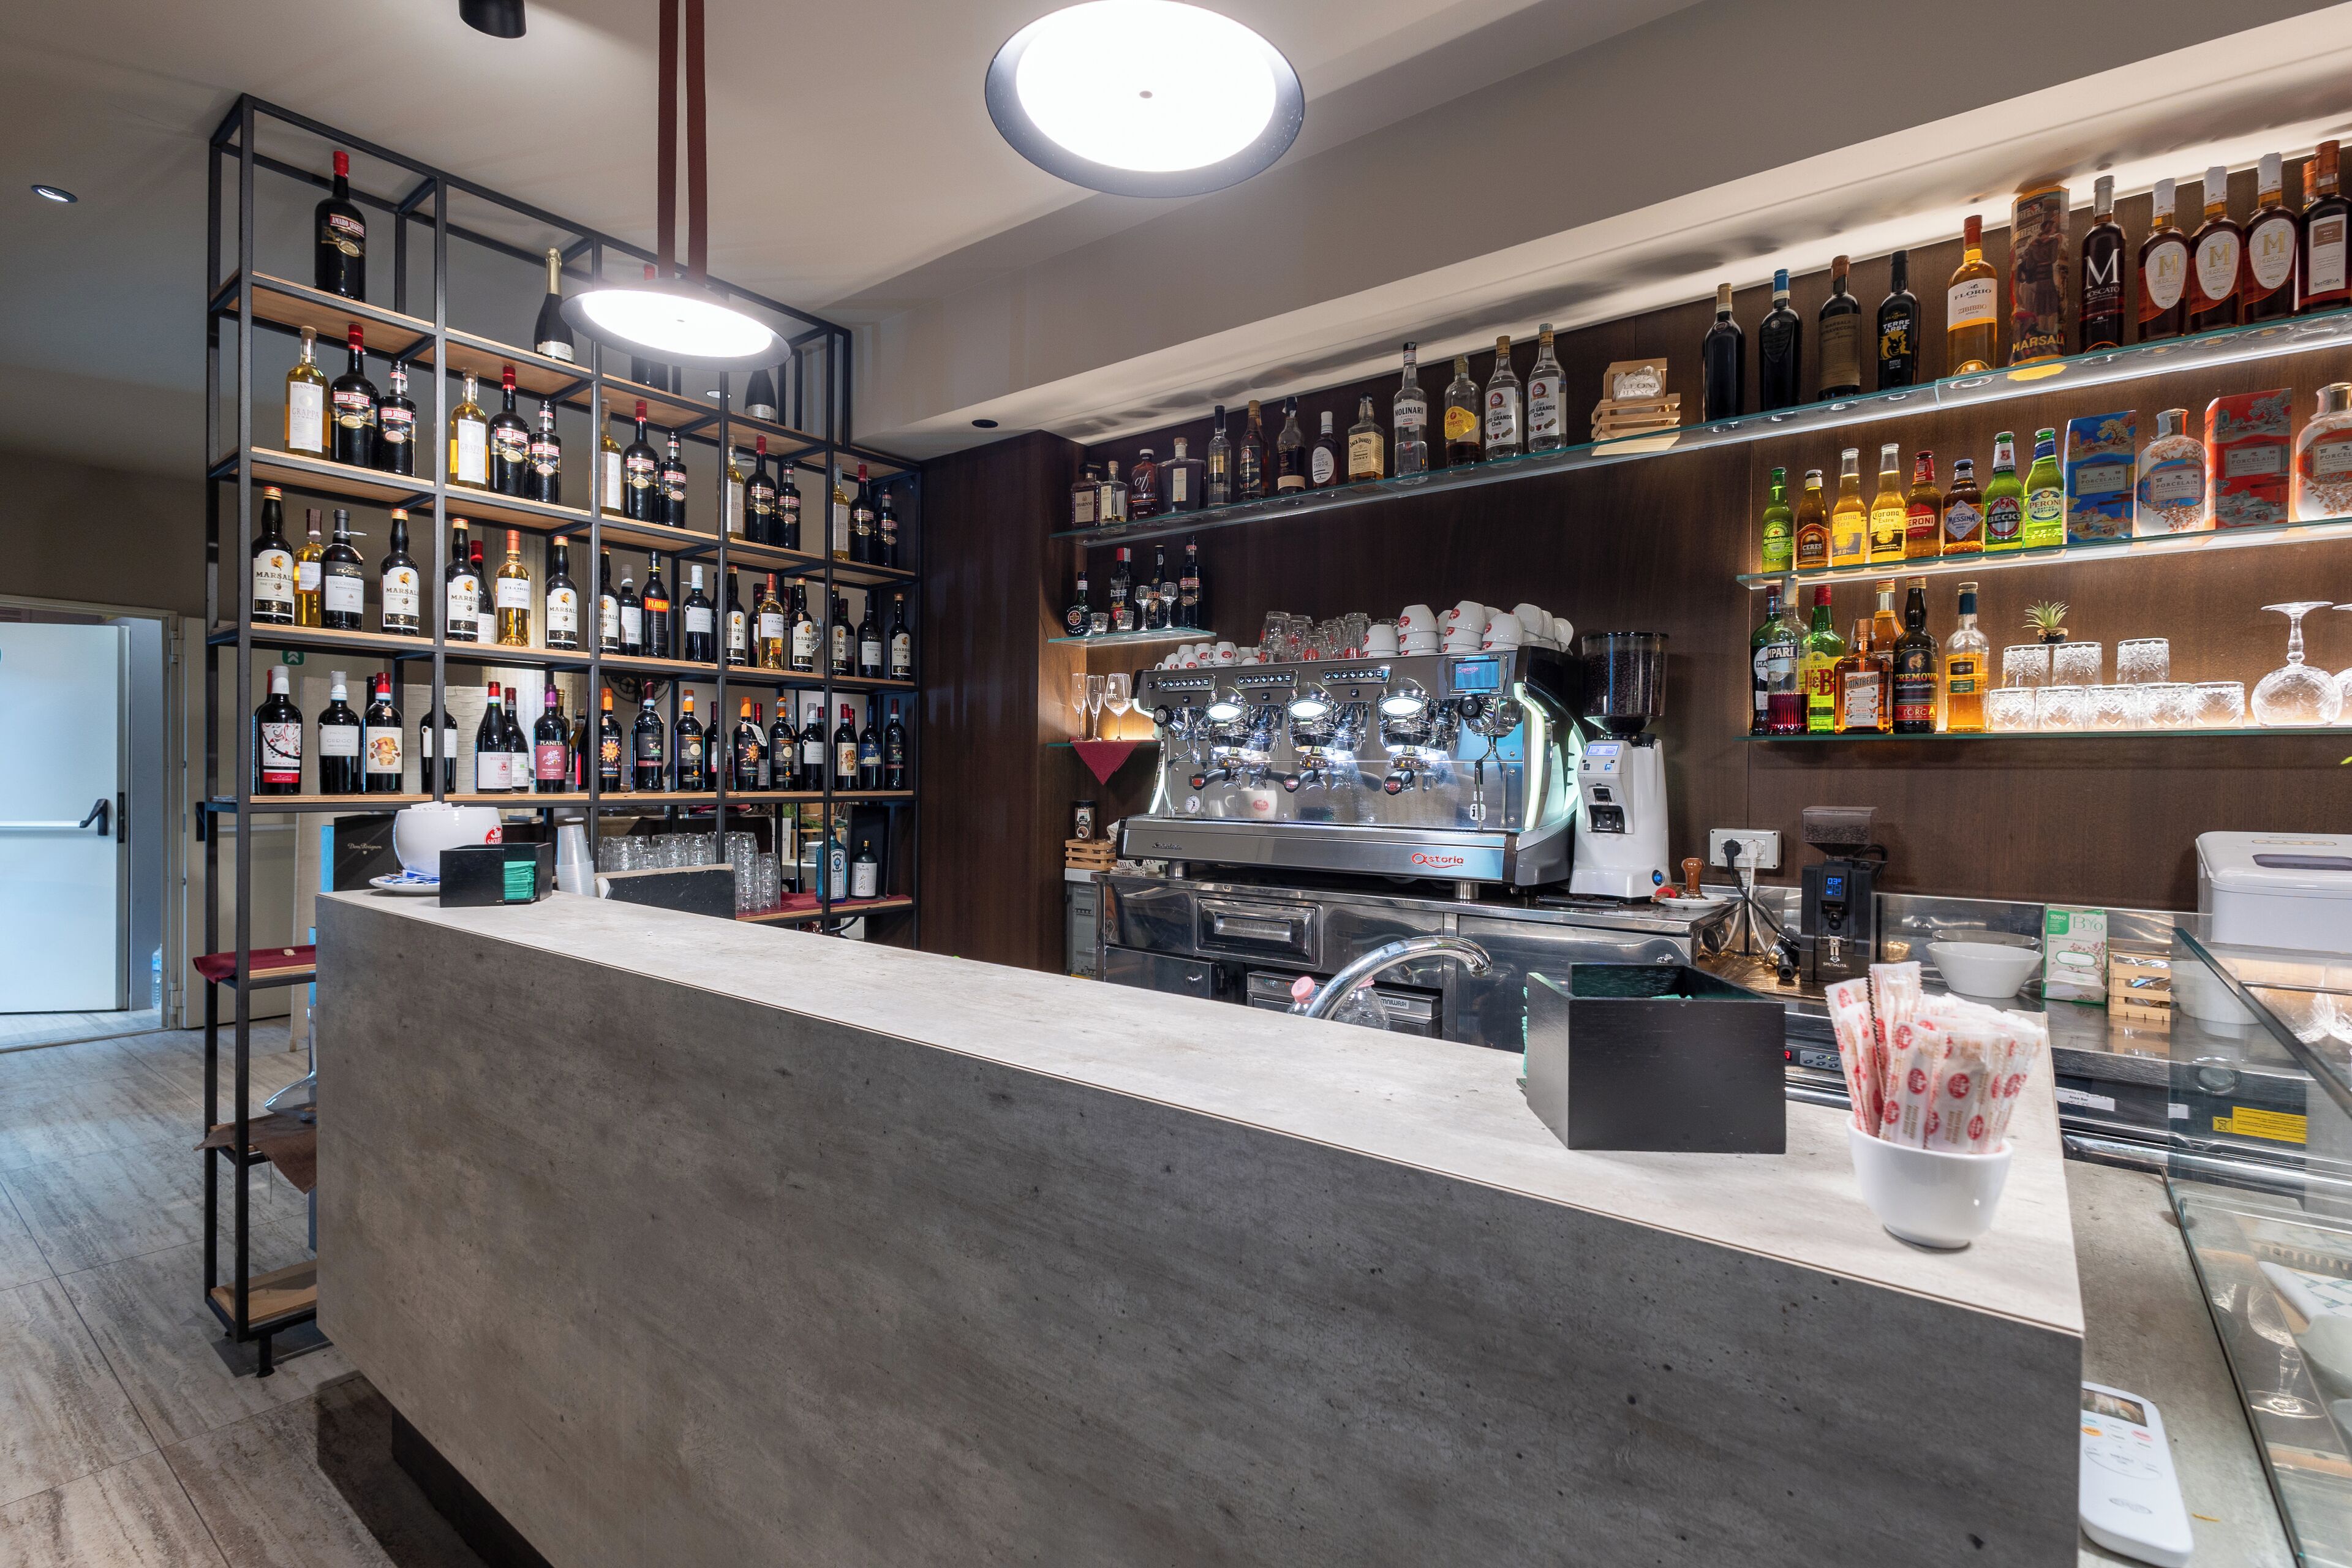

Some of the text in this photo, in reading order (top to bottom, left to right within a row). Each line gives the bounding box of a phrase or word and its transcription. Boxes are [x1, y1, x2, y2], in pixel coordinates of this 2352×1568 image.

[2263, 231, 2286, 257] M
[2209, 243, 2231, 268] M
[2084, 249, 2120, 291] M
[2158, 253, 2179, 277] M
[1954, 288, 1992, 300] FLORIO
[1958, 304, 1987, 314] ZIBIBBO
[1883, 320, 1910, 329] TERRE
[1885, 325, 1907, 334] ARSE
[2012, 333, 2065, 353] MARSALA
[292, 407, 320, 419] GRAPPA
[1395, 407, 1423, 416] MOLINARI
[1349, 439, 1358, 448] JACK
[2231, 456, 2275, 465] PORCELAIN
[1134, 470, 1152, 492] of
[2081, 476, 2121, 484] PORCELAIN
[2155, 480, 2198, 489] PORCELAIN
[2029, 499, 2061, 509] PERONI
[1872, 510, 1899, 520] Corona
[1947, 513, 1976, 525] MESSINA
[1988, 512, 2021, 522] BECK'S
[1845, 674, 1878, 689] COINTREAU
